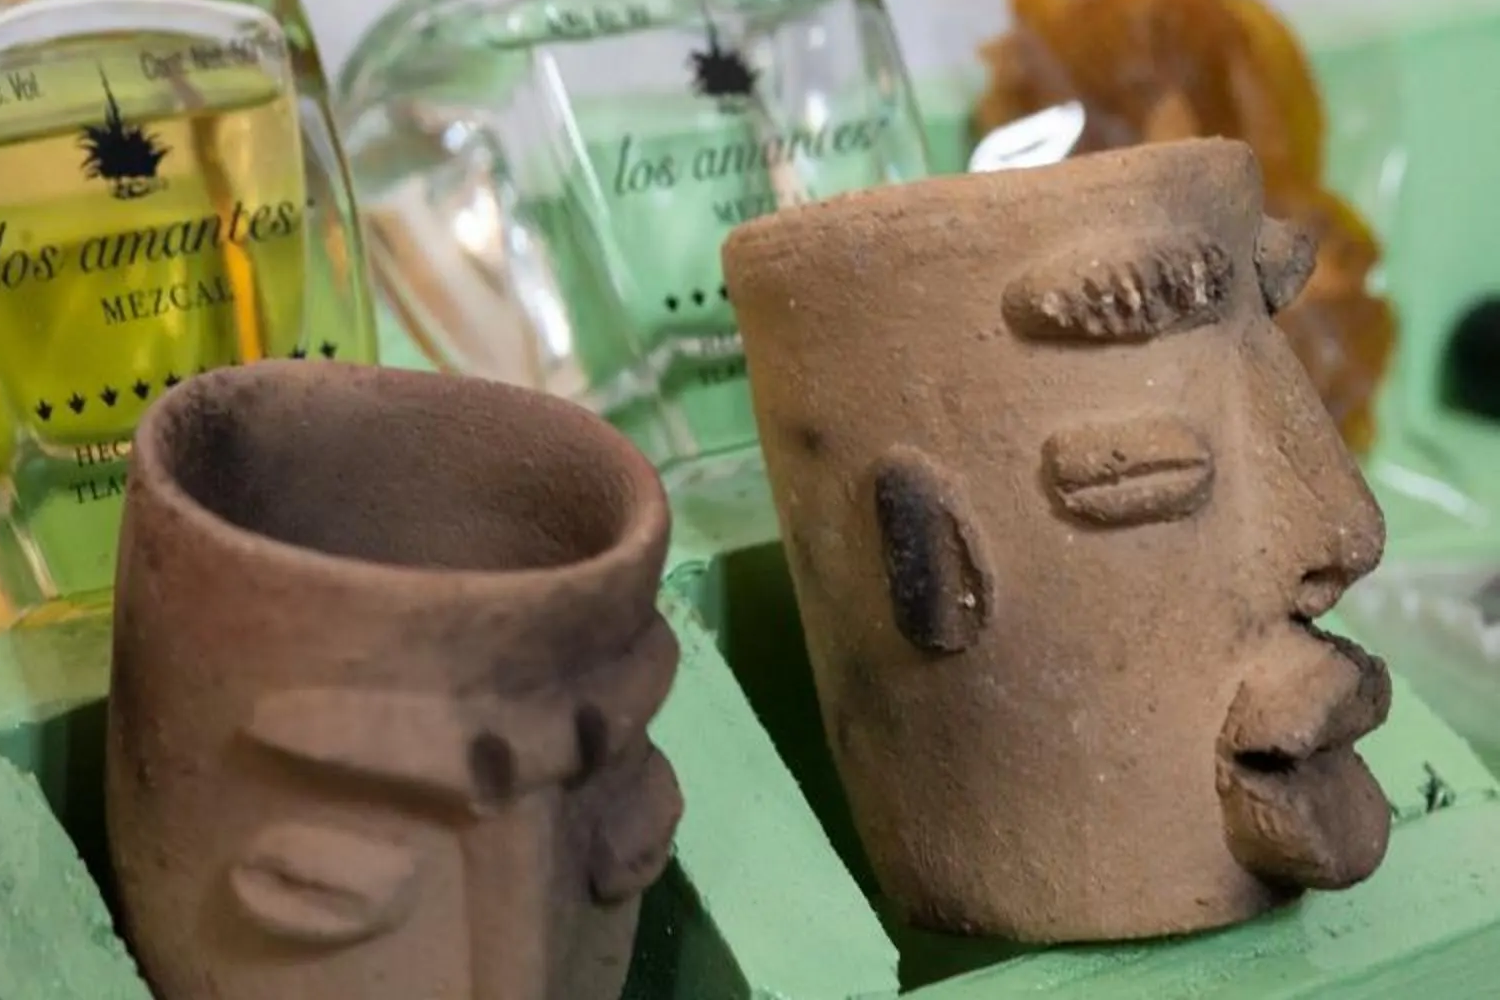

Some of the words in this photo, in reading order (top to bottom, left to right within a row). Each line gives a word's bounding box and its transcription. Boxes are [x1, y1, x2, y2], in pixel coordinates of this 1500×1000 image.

[613, 132, 676, 197] los
[78, 199, 296, 276] amantes
[101, 275, 237, 326] MEZCAL
[75, 436, 130, 468] HEC
